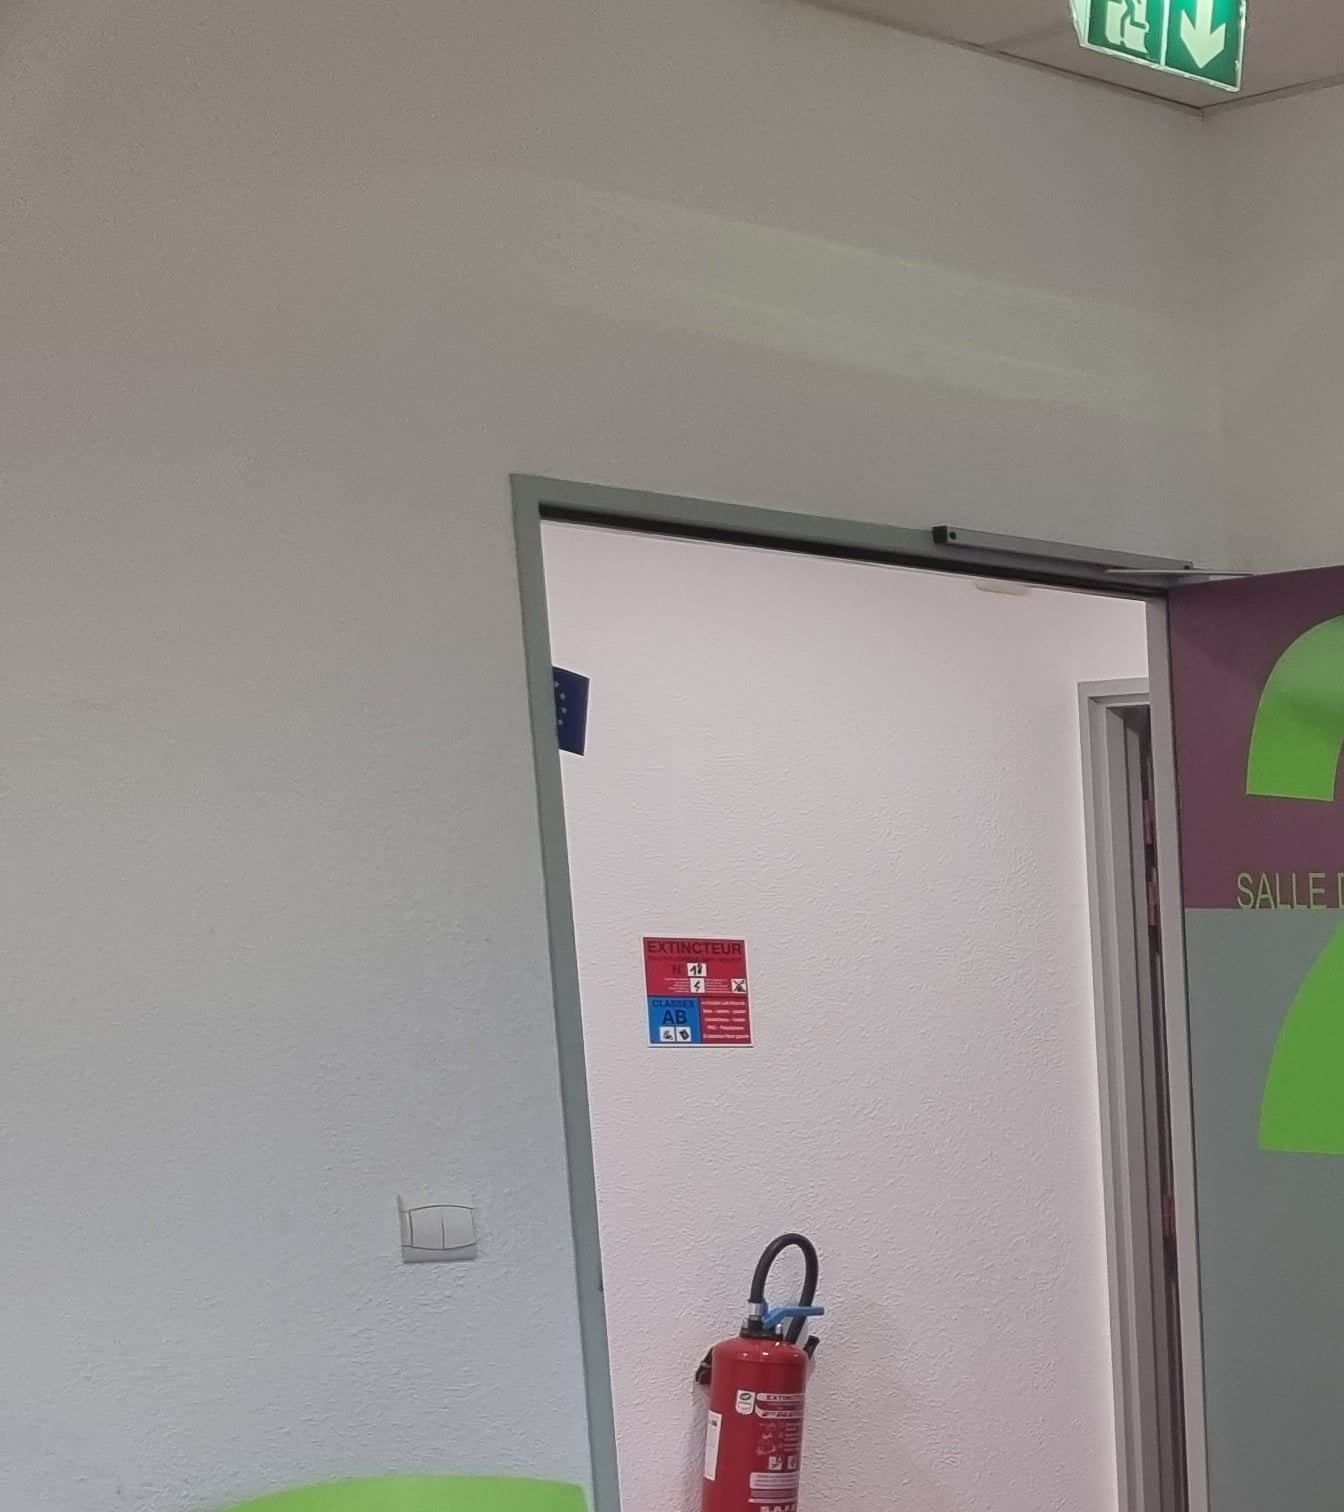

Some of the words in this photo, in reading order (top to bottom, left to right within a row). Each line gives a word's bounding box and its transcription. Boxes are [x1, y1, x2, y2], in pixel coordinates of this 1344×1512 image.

[1237, 872, 1327, 910] SALLE
[648, 941, 742, 956] EXTINCTEUR
[662, 1009, 688, 1025] AB
